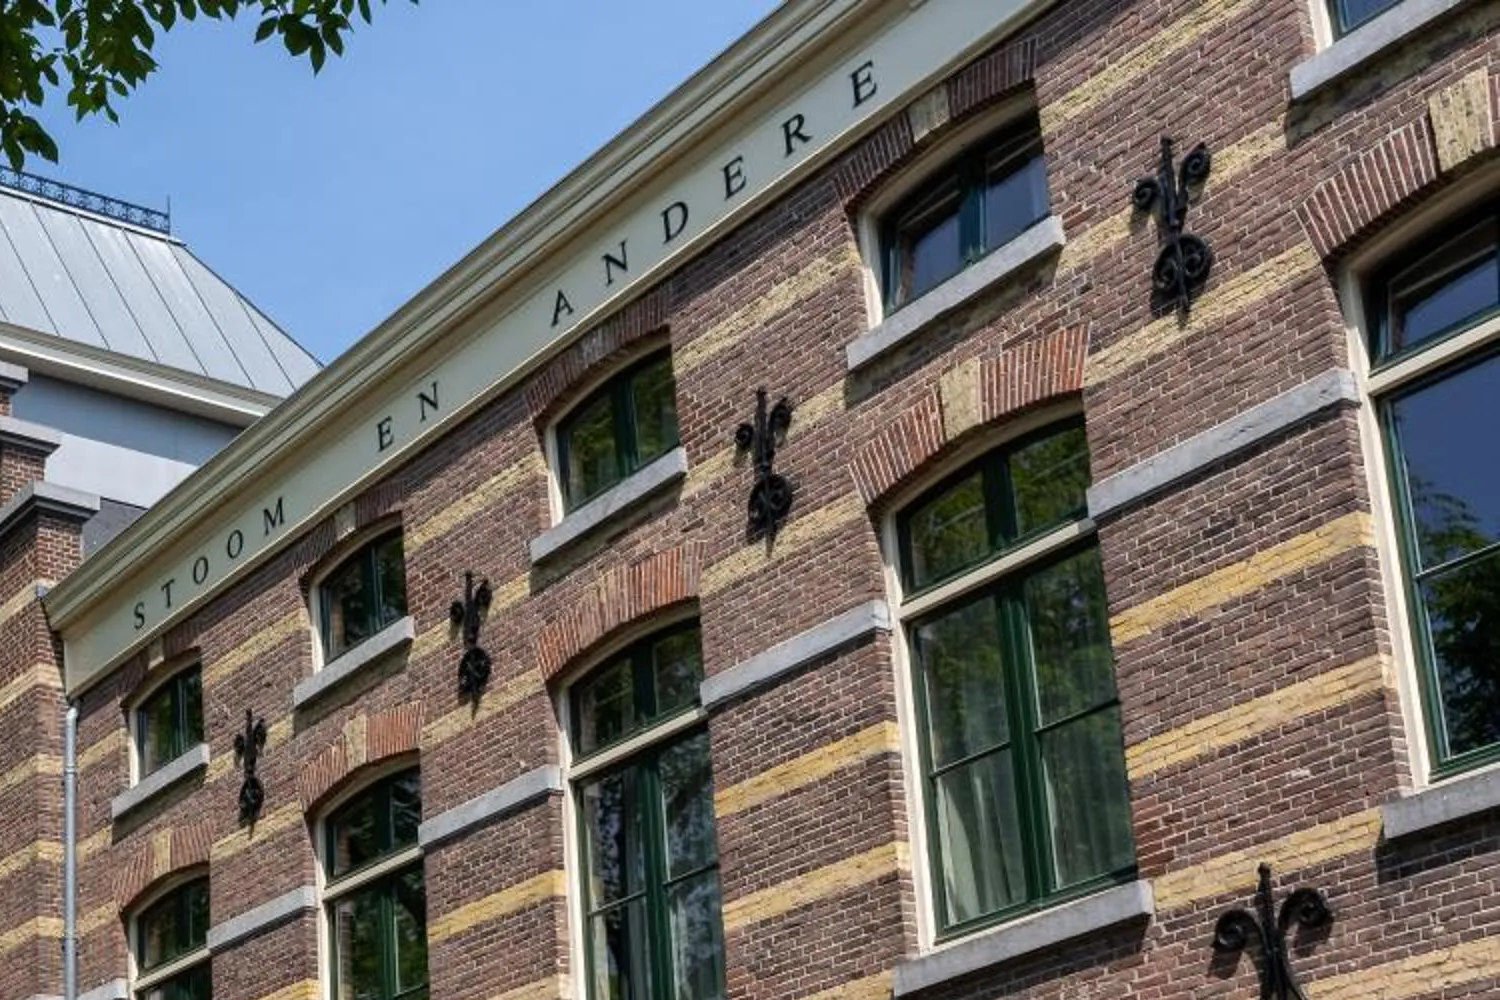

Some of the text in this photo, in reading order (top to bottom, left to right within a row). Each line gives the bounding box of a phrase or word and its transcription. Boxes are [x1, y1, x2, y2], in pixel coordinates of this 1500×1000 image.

[133, 61, 878, 631] STOOM EN ANDERE
